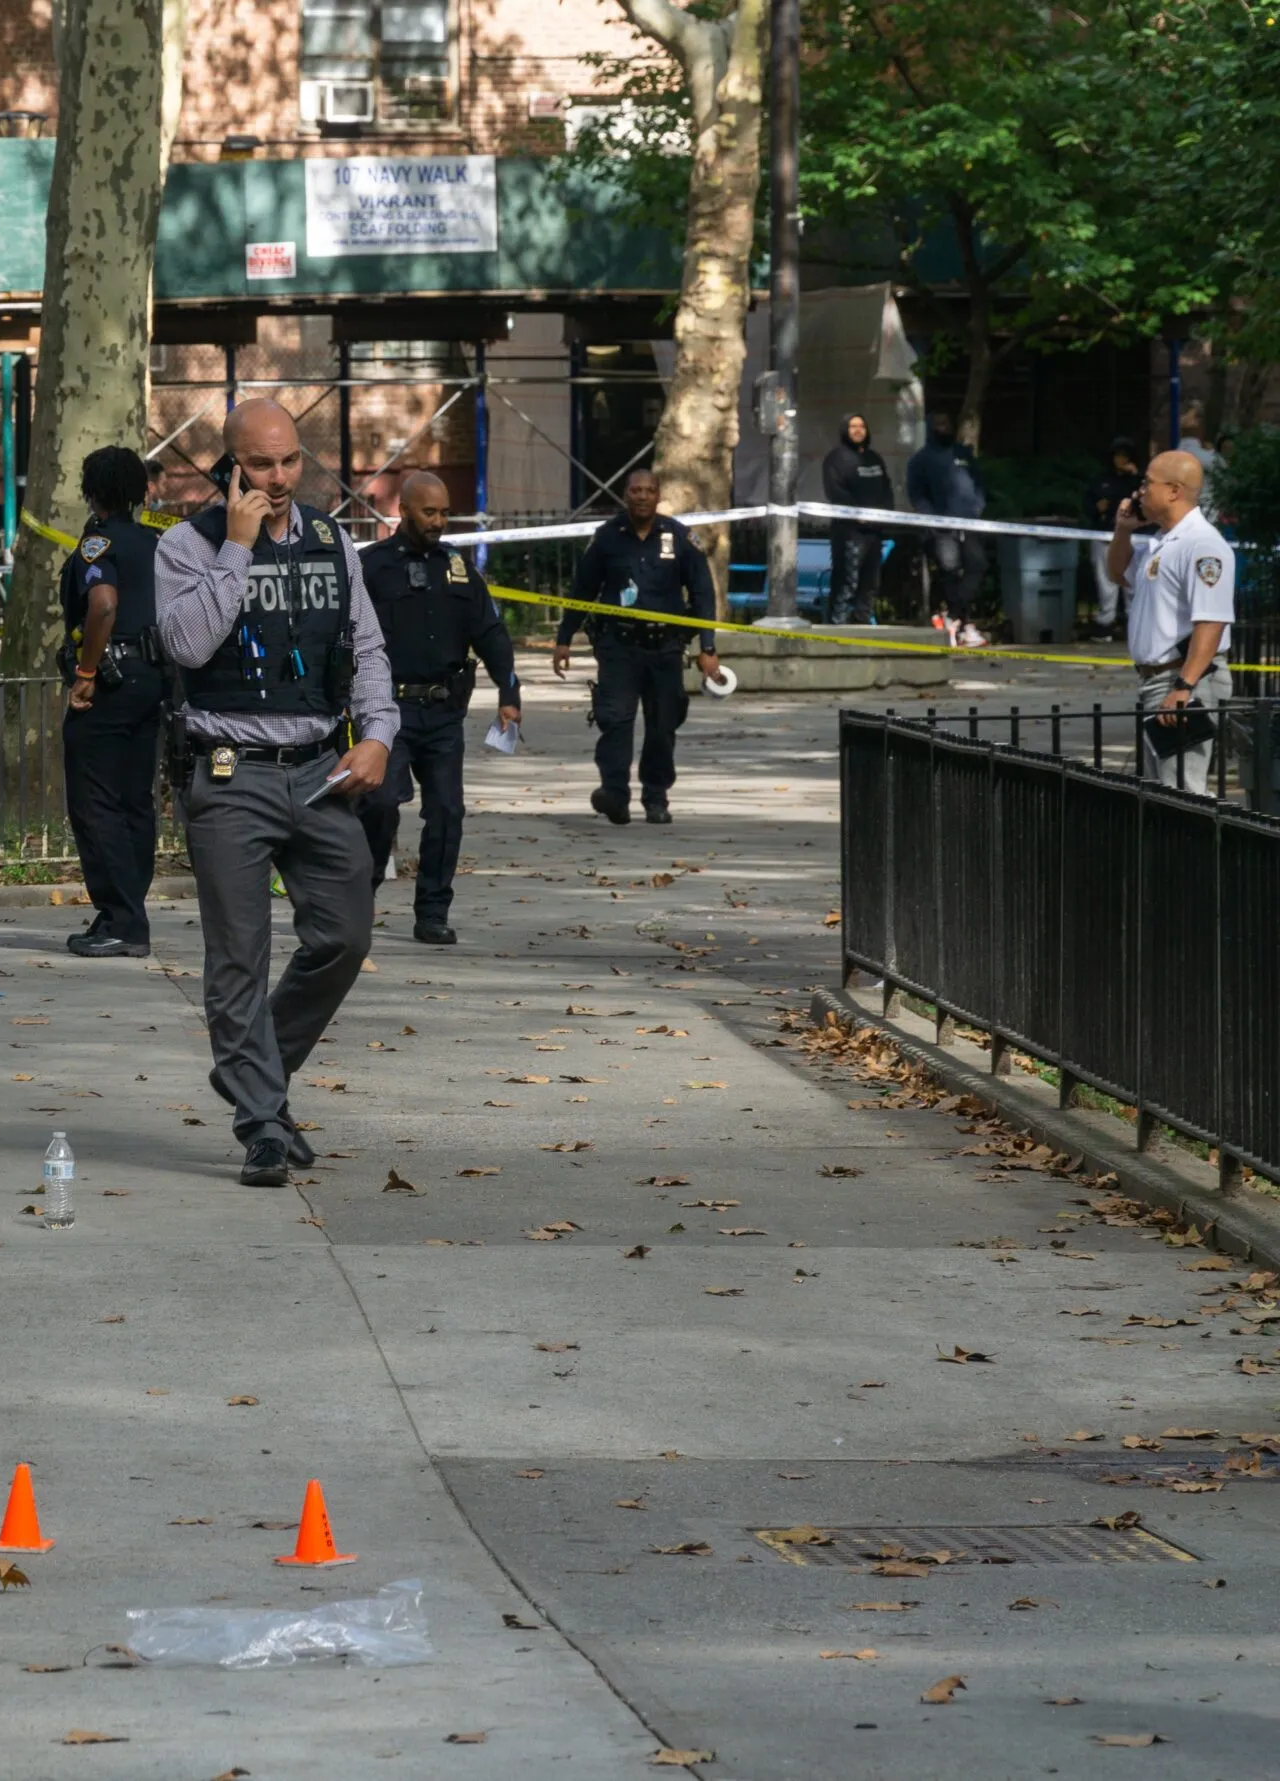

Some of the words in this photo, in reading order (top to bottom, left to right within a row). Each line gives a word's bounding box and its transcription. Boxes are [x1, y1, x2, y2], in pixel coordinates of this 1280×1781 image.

[368, 164, 413, 184] NAVY
[417, 164, 467, 184] WALK
[358, 194, 437, 209] VIKRANT
[349, 222, 448, 236] SCAFFOLDING
[244, 575, 340, 613] POLICE
